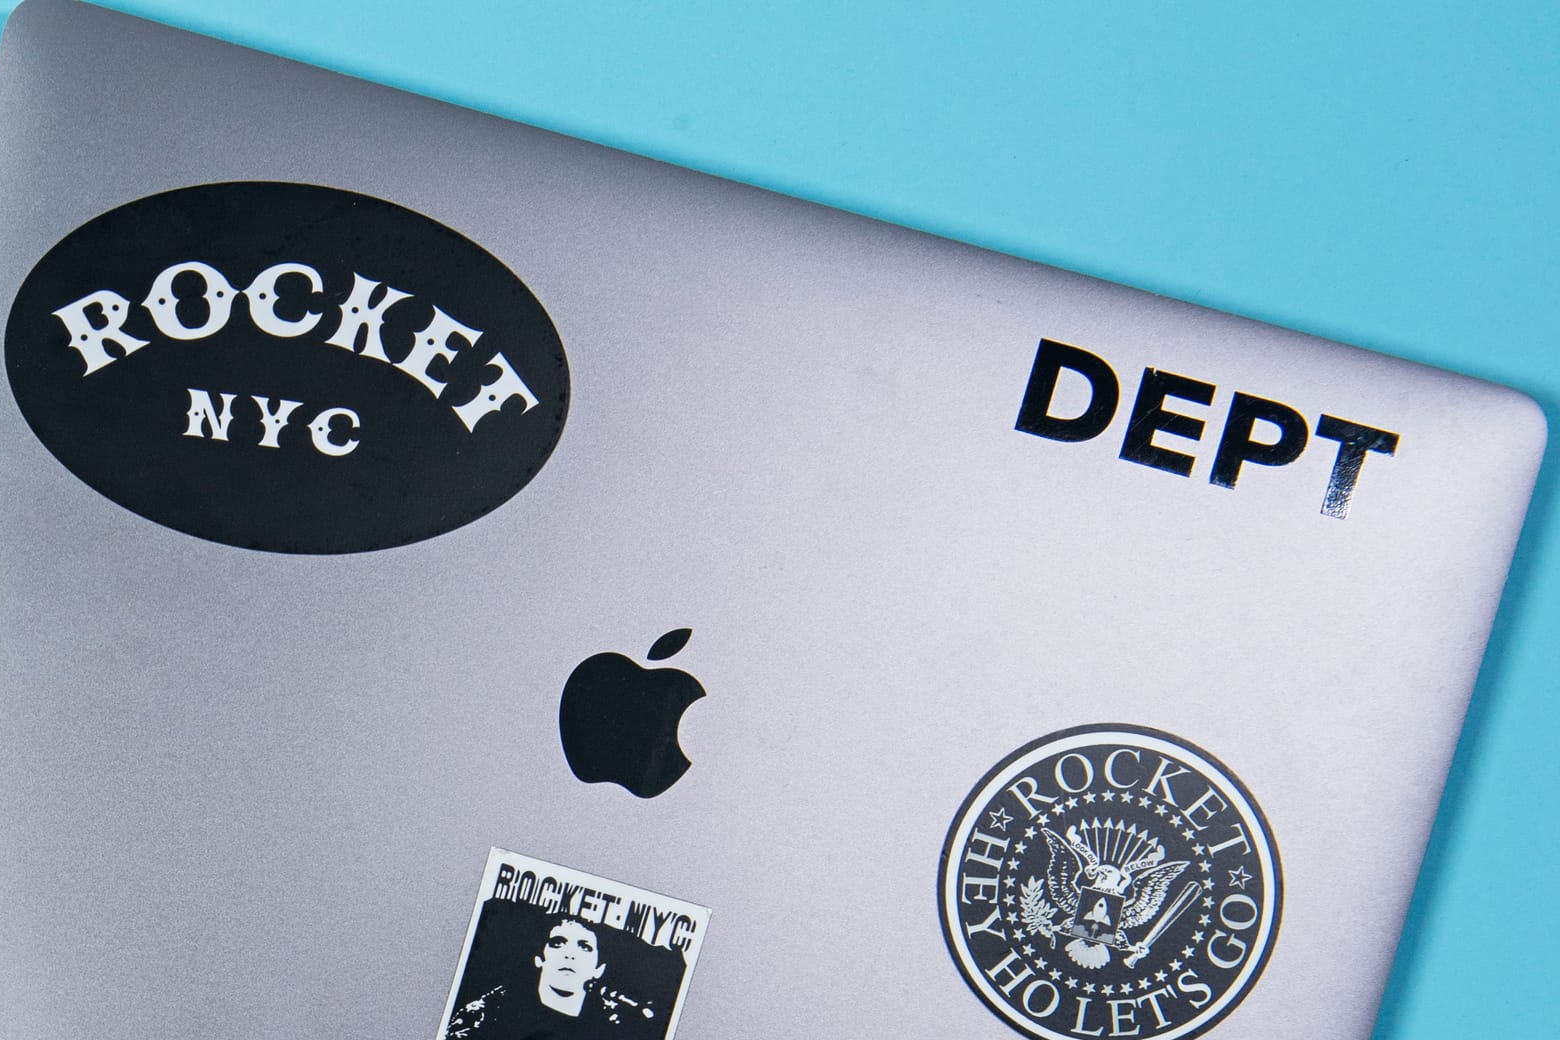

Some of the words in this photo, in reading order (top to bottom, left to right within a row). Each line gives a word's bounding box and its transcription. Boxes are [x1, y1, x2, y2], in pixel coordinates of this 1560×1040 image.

[51, 261, 540, 433] ROCKET
[182, 388, 360, 456] NYC
[1014, 337, 1400, 520] DEPT
[1007, 749, 1252, 858] ROCKET
[1124, 859, 1155, 873] BELOW
[961, 827, 1011, 941] HEY
[986, 948, 1061, 1018] HO
[1070, 969, 1213, 1037] LET'S
[1206, 894, 1258, 970] GO
